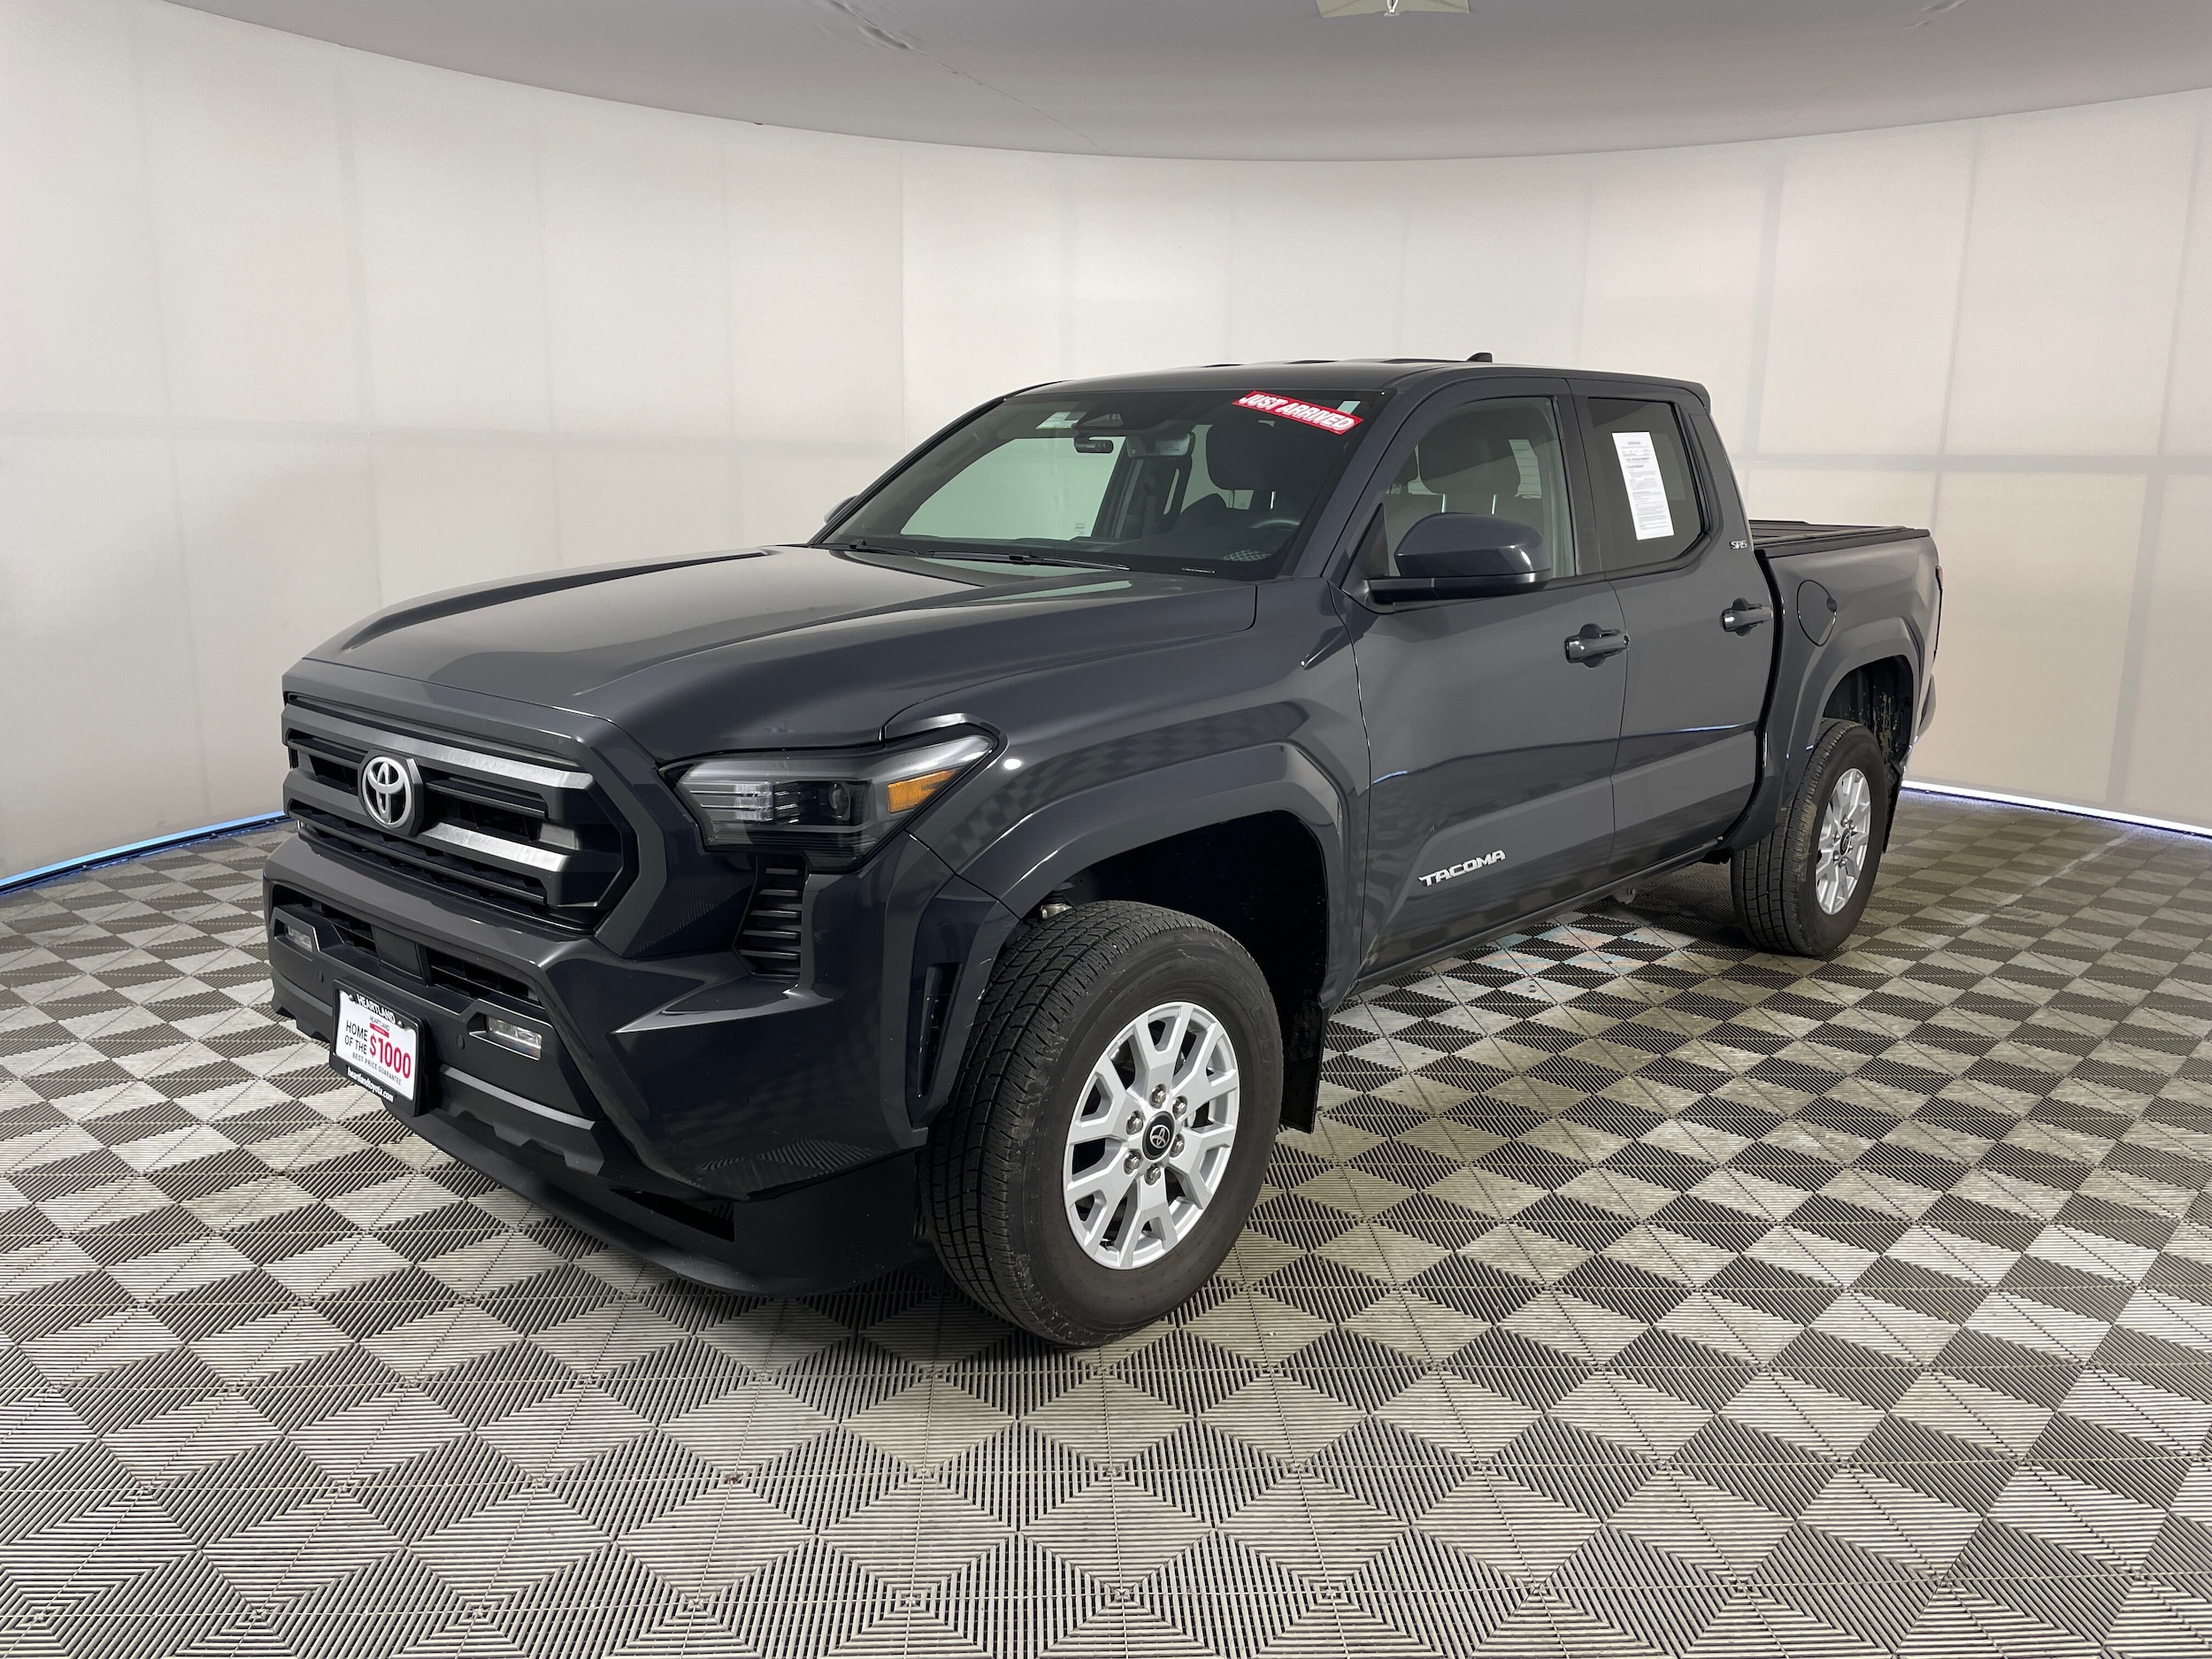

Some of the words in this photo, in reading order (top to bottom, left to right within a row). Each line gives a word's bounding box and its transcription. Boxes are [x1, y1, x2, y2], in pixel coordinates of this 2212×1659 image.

[1239, 394, 1288, 411] JUST
[1275, 402, 1356, 431] ARRIVED
[1418, 849, 1506, 887] TACOMA
[356, 994, 396, 1024] HEARTLAND
[369, 1015, 390, 1032] HEARTLAND
[344, 1034, 354, 1046] OF
[354, 1039, 367, 1055] THE
[345, 1019, 368, 1042] HOME
[352, 1051, 363, 1063] BEST
[365, 1057, 377, 1071] PRICE
[378, 1065, 403, 1087] GUARANTEE
[369, 1033, 411, 1079] $1000
[347, 1066, 395, 1103] heartlandtoyota.com
